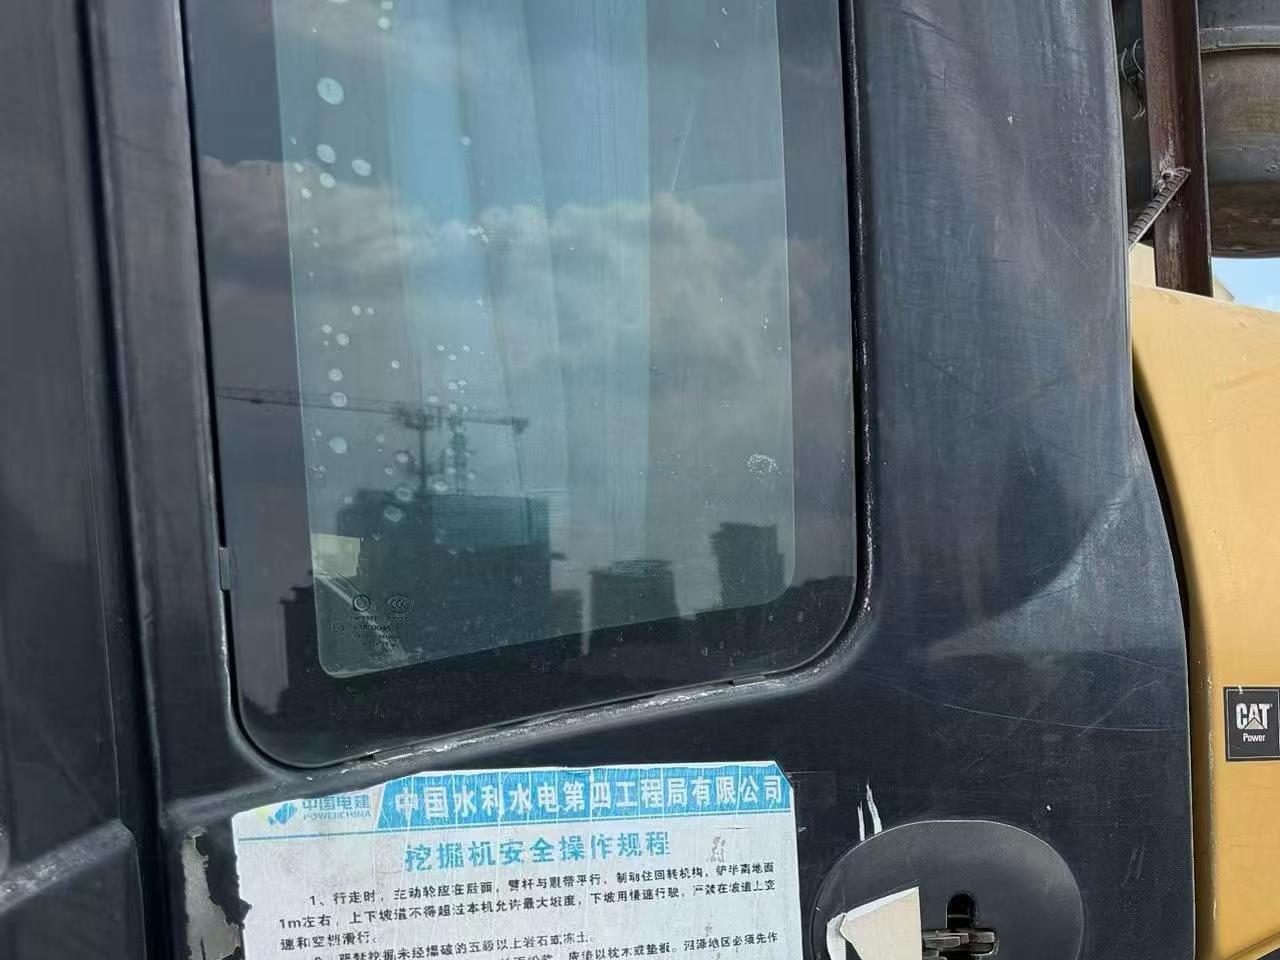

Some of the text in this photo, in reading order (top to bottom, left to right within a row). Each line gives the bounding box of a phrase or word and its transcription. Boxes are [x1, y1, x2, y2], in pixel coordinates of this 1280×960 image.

[1235, 702, 1271, 730] CAT
[1243, 733, 1266, 743] Power
[302, 794, 371, 811] 中国电建
[394, 774, 783, 821] 中国水利水电第四工程局有限公司
[405, 830, 670, 872] 挖掘机安全操作规程
